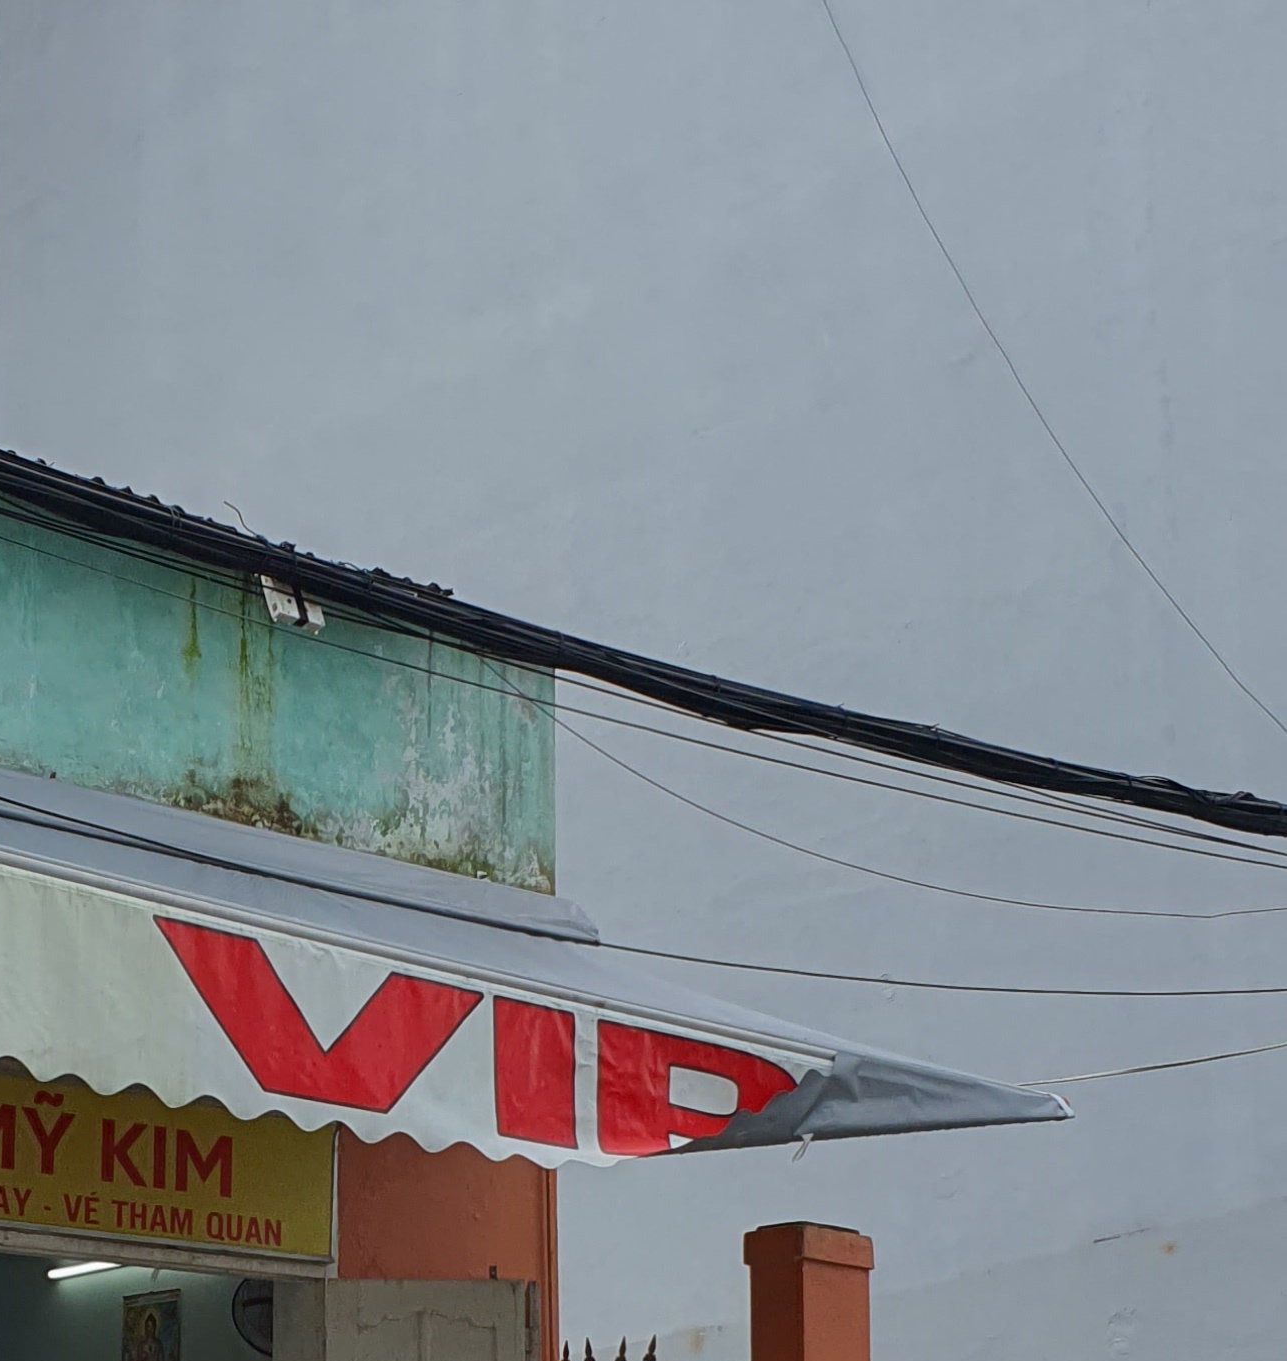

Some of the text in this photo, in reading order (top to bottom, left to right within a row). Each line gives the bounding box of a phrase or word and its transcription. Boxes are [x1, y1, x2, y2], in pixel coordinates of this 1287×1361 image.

[153, 915, 799, 1157] VIP
[100, 1118, 234, 1199] KIM
[63, 1190, 101, 1226] VÉ
[110, 1199, 194, 1236] THAM
[205, 1211, 283, 1247] QUAN
